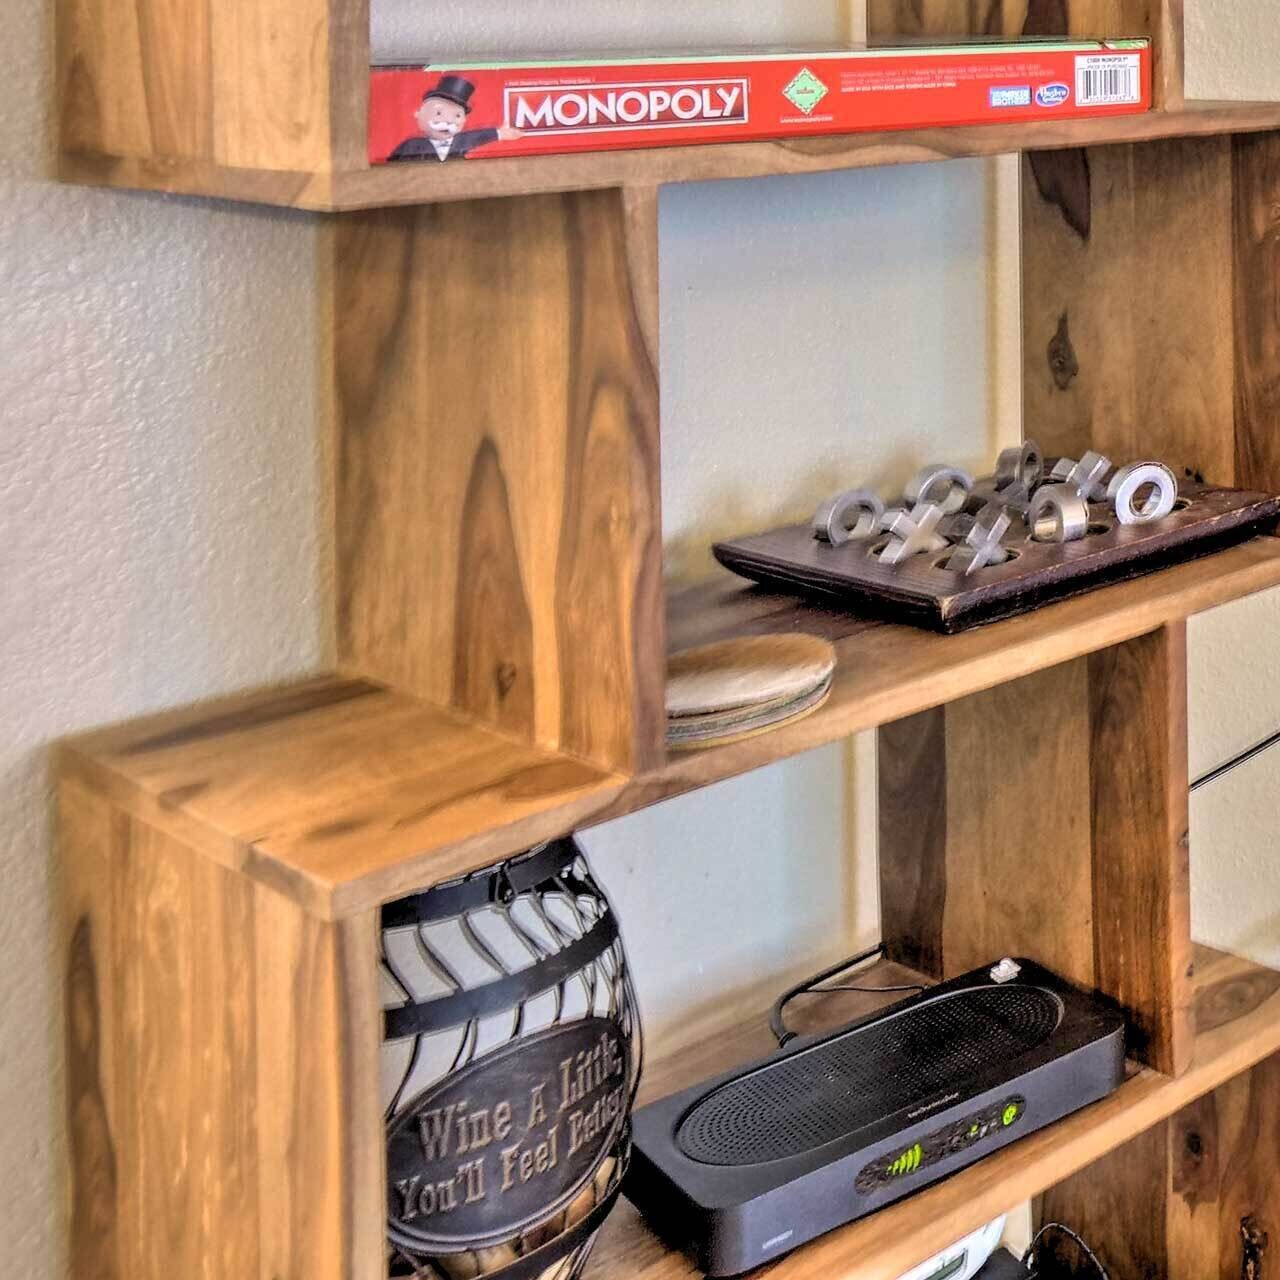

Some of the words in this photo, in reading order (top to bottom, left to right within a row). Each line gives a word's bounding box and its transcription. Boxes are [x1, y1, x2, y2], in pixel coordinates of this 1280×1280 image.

[515, 86, 740, 129] MONOPOLY
[418, 1101, 513, 1161] Wine
[527, 1082, 548, 1129] A
[393, 1158, 487, 1224] You'll
[499, 1124, 559, 1193] Feel
